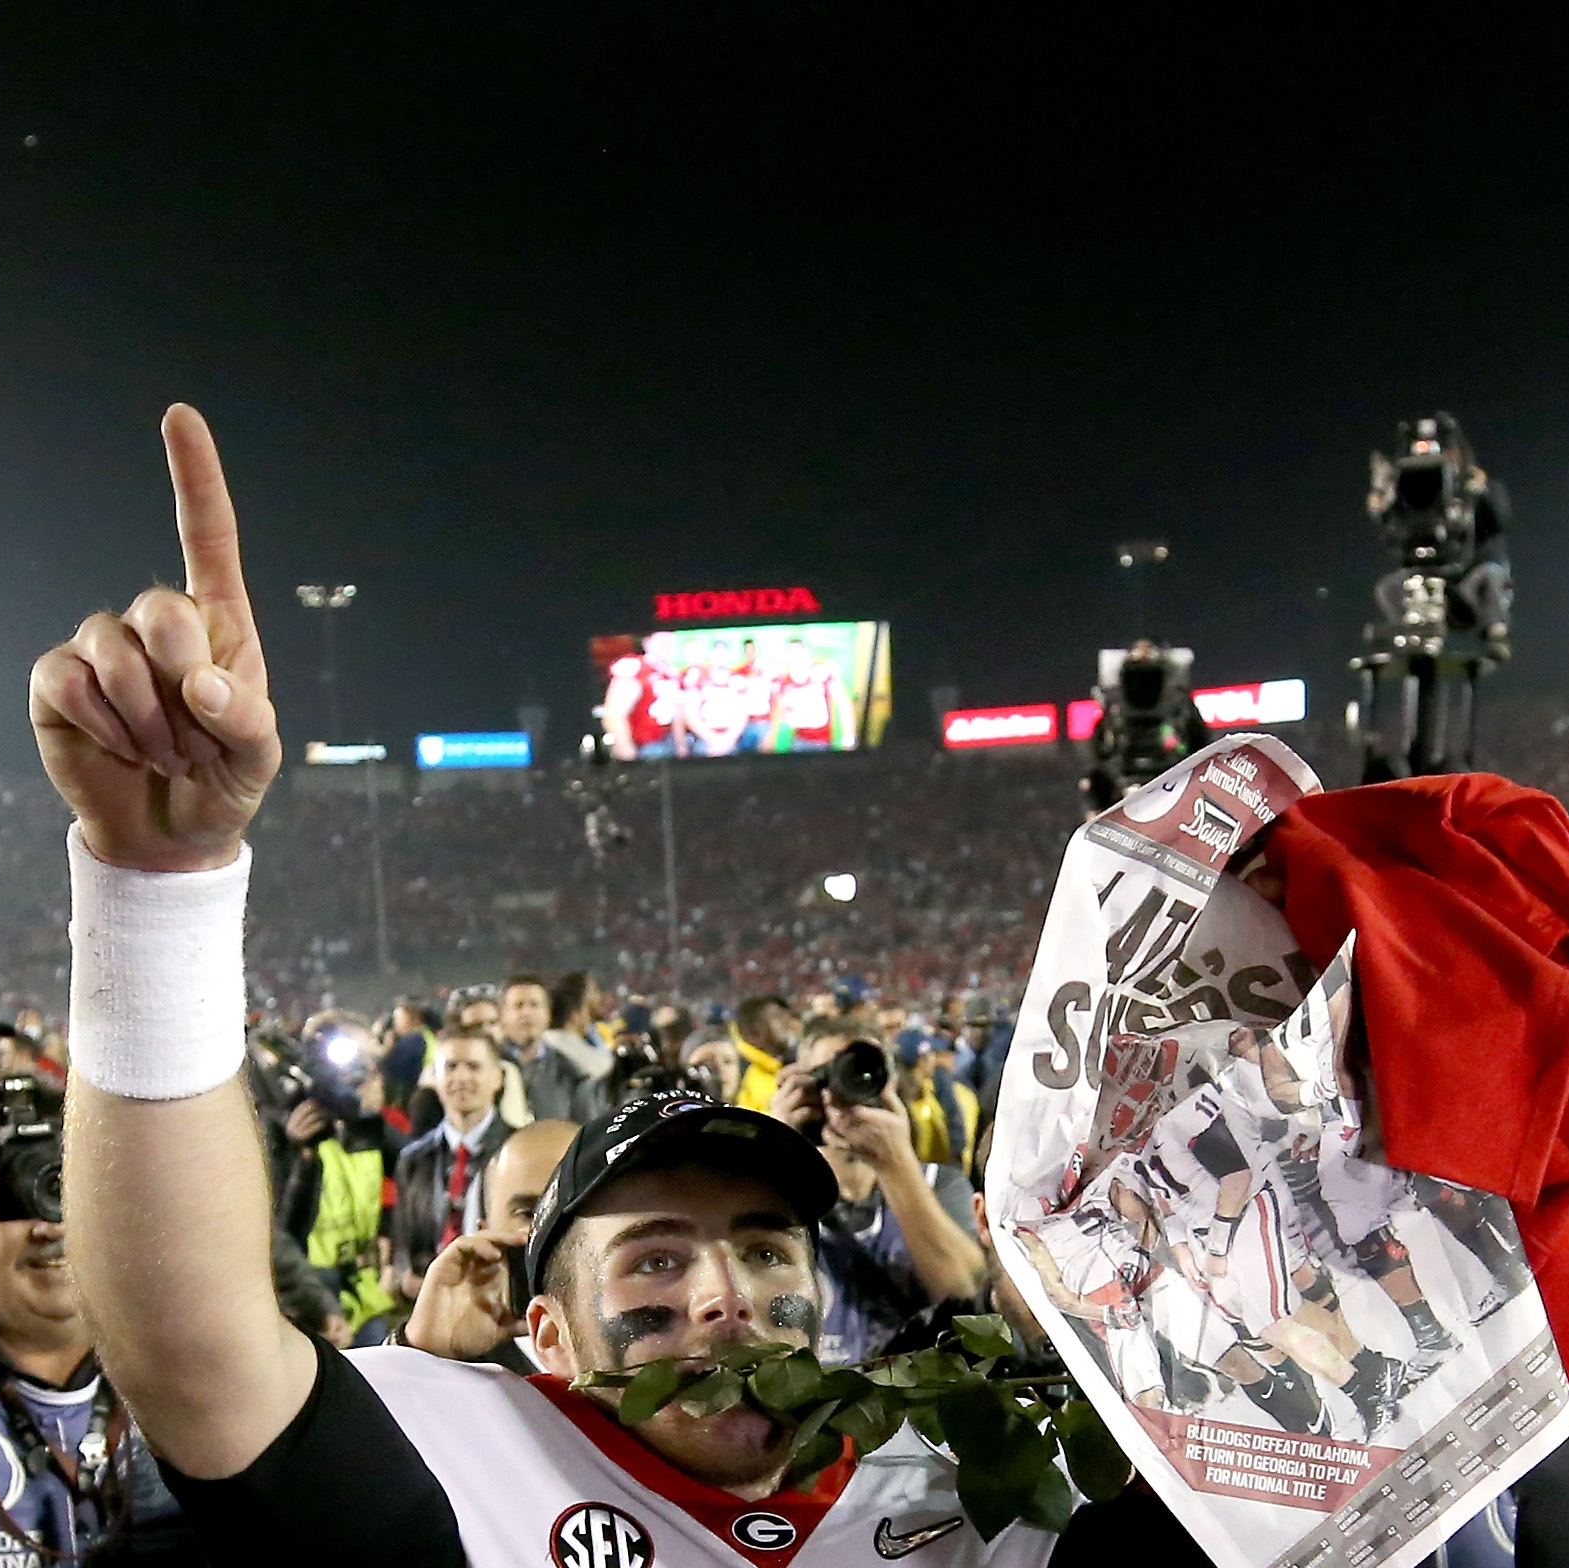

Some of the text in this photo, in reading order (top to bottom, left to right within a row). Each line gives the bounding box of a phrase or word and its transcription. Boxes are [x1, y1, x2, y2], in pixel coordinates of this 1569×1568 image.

[655, 587, 821, 620] HONDA
[1185, 1443, 1360, 1486] RETURN TO GEORGIA TO PLAY
[1186, 1423, 1252, 1450] BULLDOGS
[1252, 1437, 1300, 1456] DEFEAT
[1299, 1441, 1372, 1470] OKLAHOMA,
[1205, 1466, 1328, 1501] FOR NATIONAL TITLE
[733, 1512, 797, 1551] G
